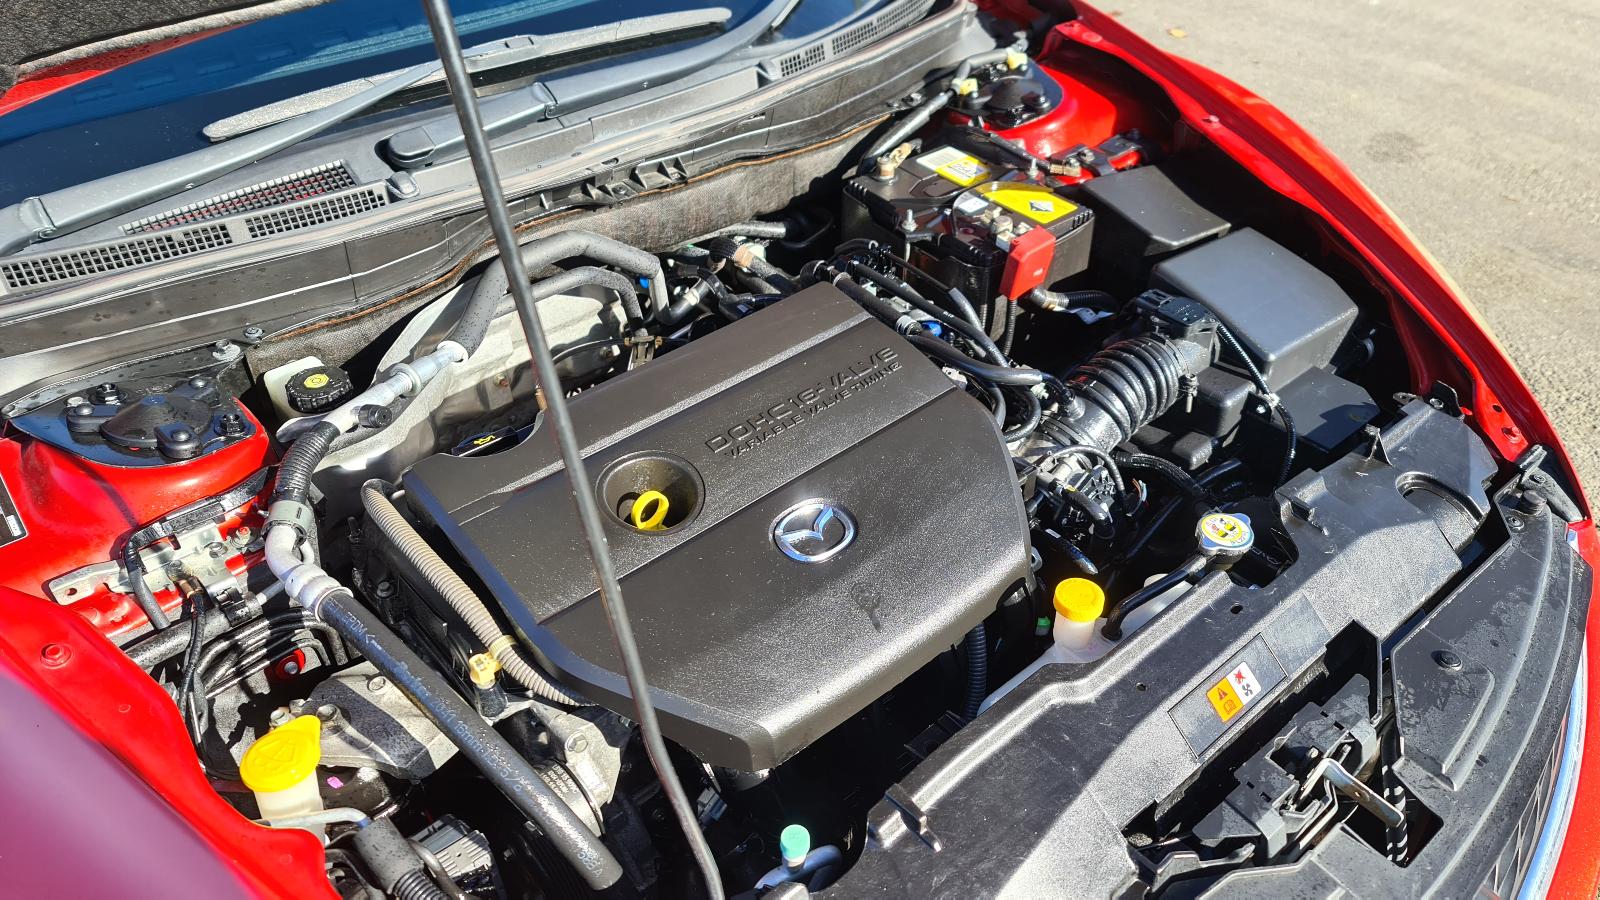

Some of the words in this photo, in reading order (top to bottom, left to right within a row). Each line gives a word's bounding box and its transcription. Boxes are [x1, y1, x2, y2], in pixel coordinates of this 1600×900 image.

[705, 402, 792, 454] DOHC
[725, 414, 805, 459] VARIABLE
[803, 388, 852, 418] VALVE
[850, 361, 903, 392] TIMING
